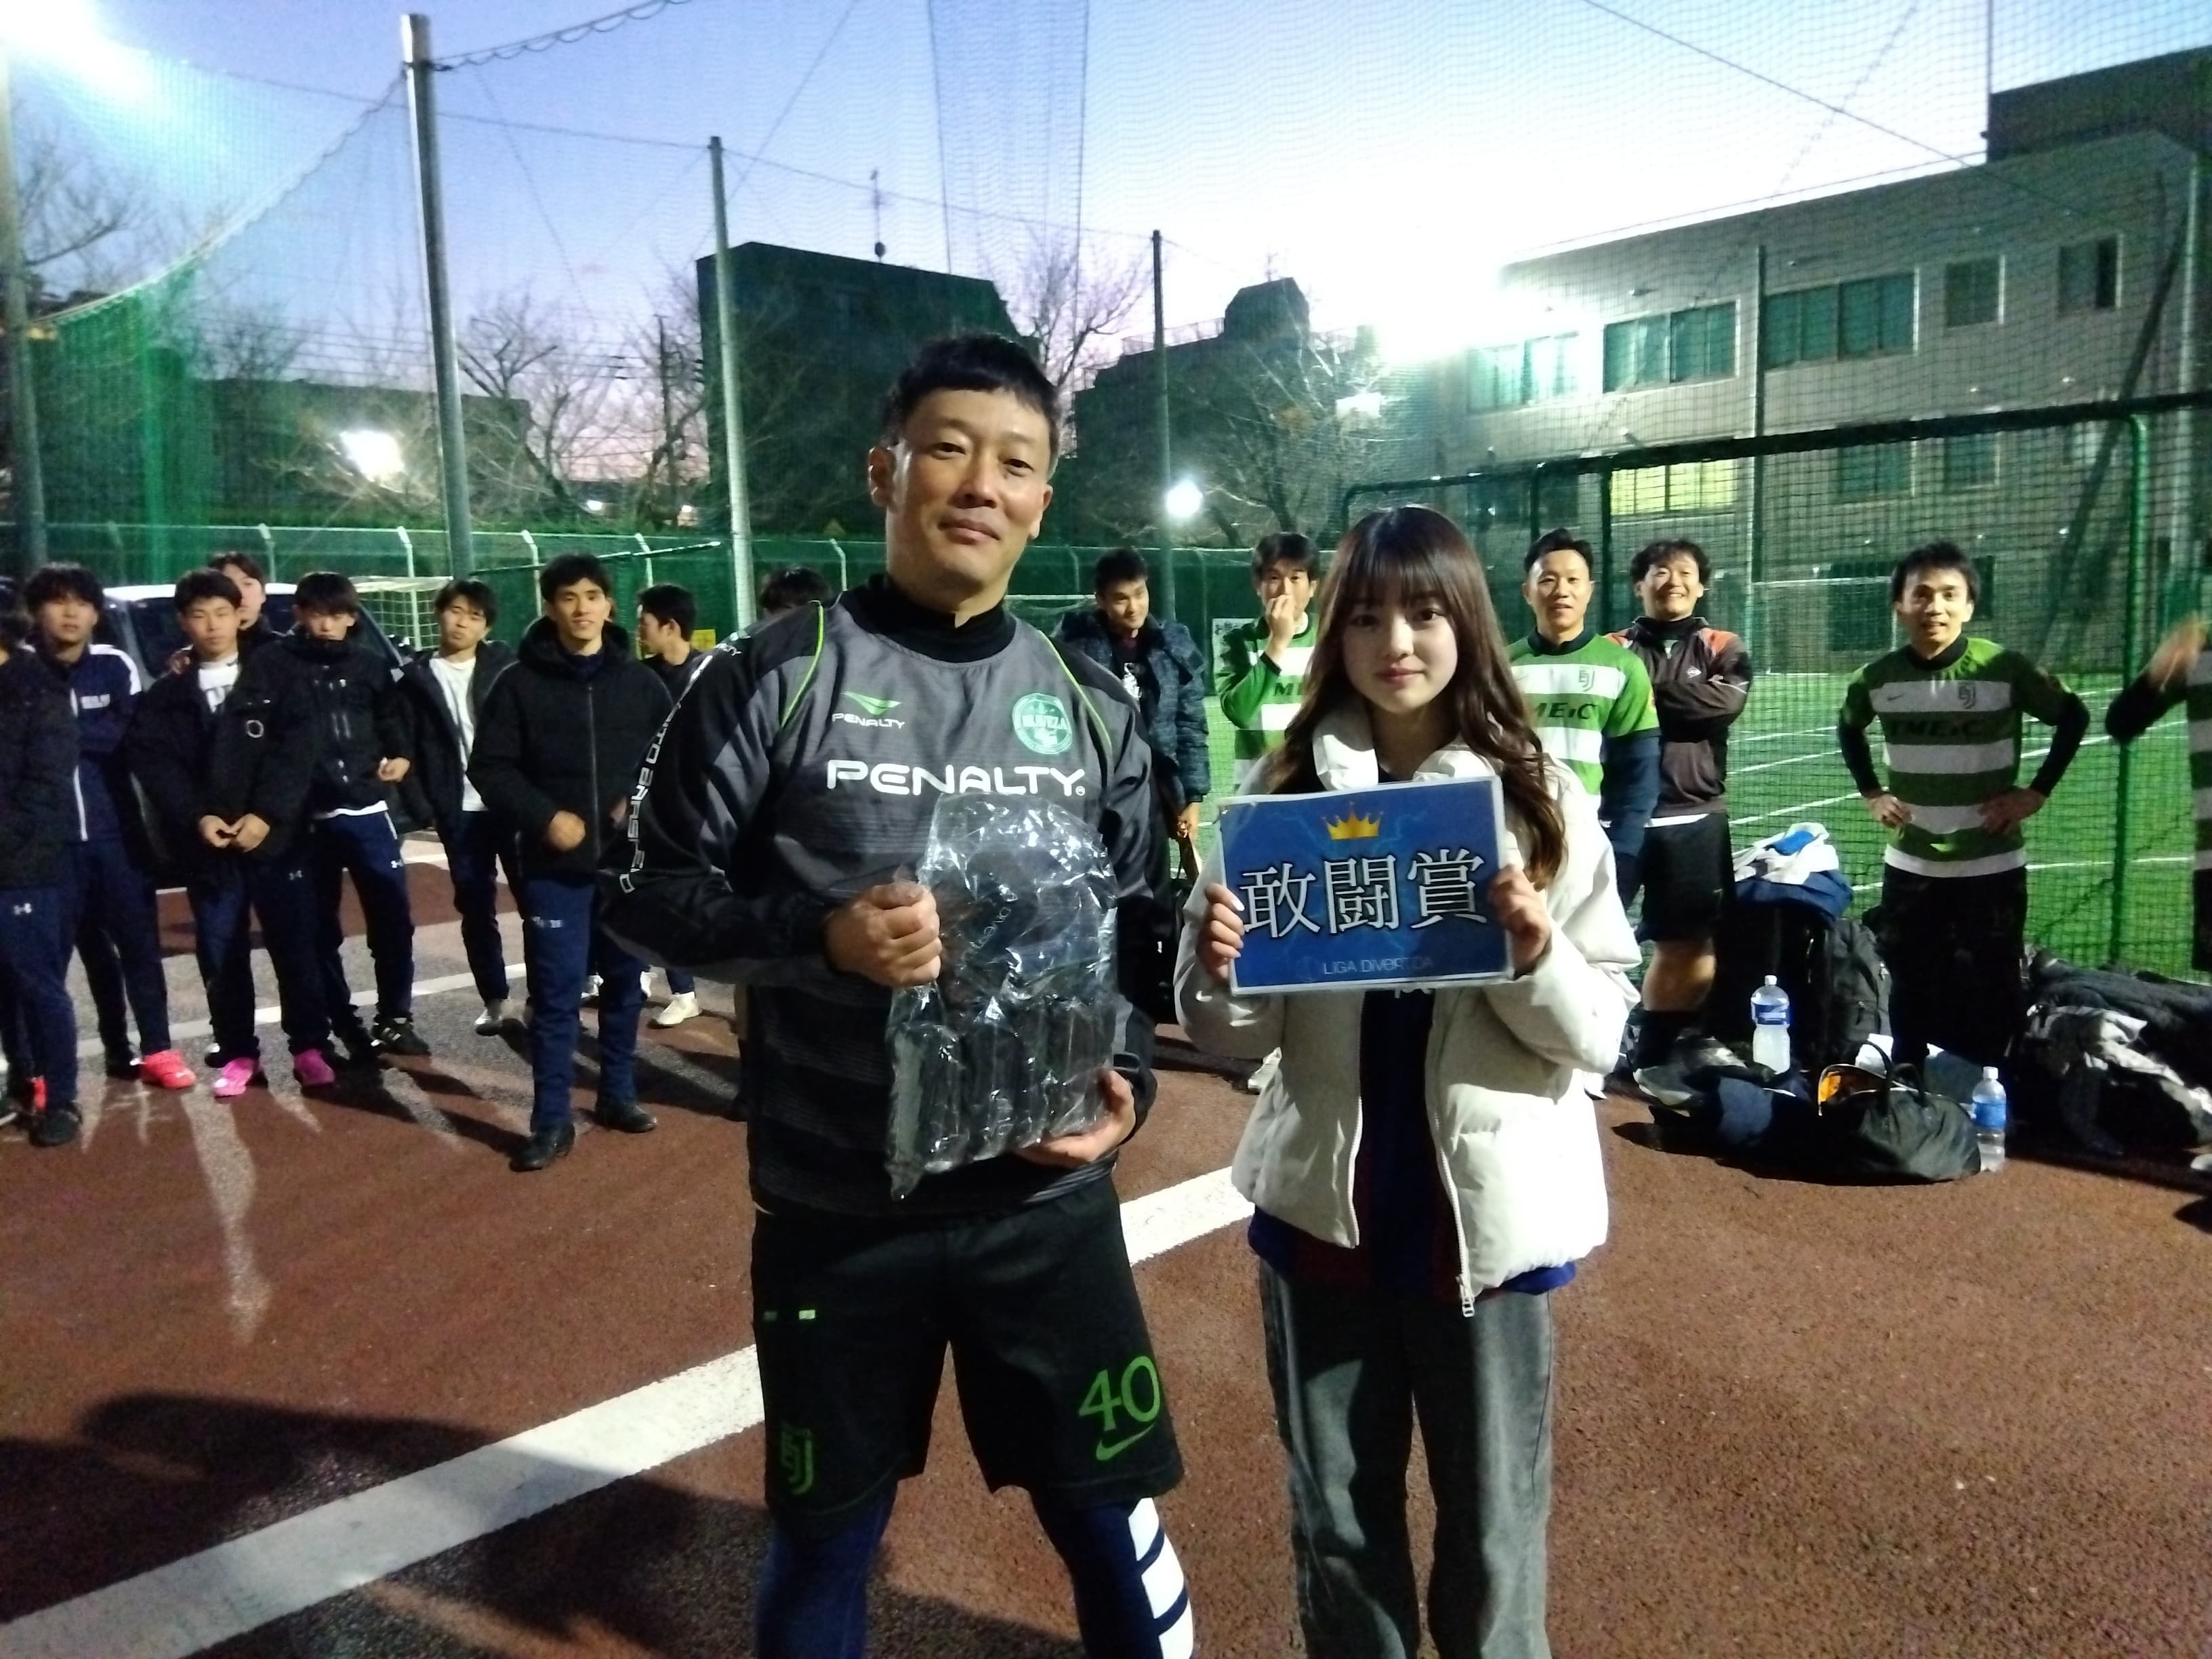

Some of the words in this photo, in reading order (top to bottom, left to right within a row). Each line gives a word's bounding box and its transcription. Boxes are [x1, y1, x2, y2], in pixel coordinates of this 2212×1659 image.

[832, 713, 905, 730] PENALTY
[826, 759, 1085, 796] PENALTY
[1240, 848, 1488, 939] 敢闘賞
[1078, 1355, 1161, 1431] 40
